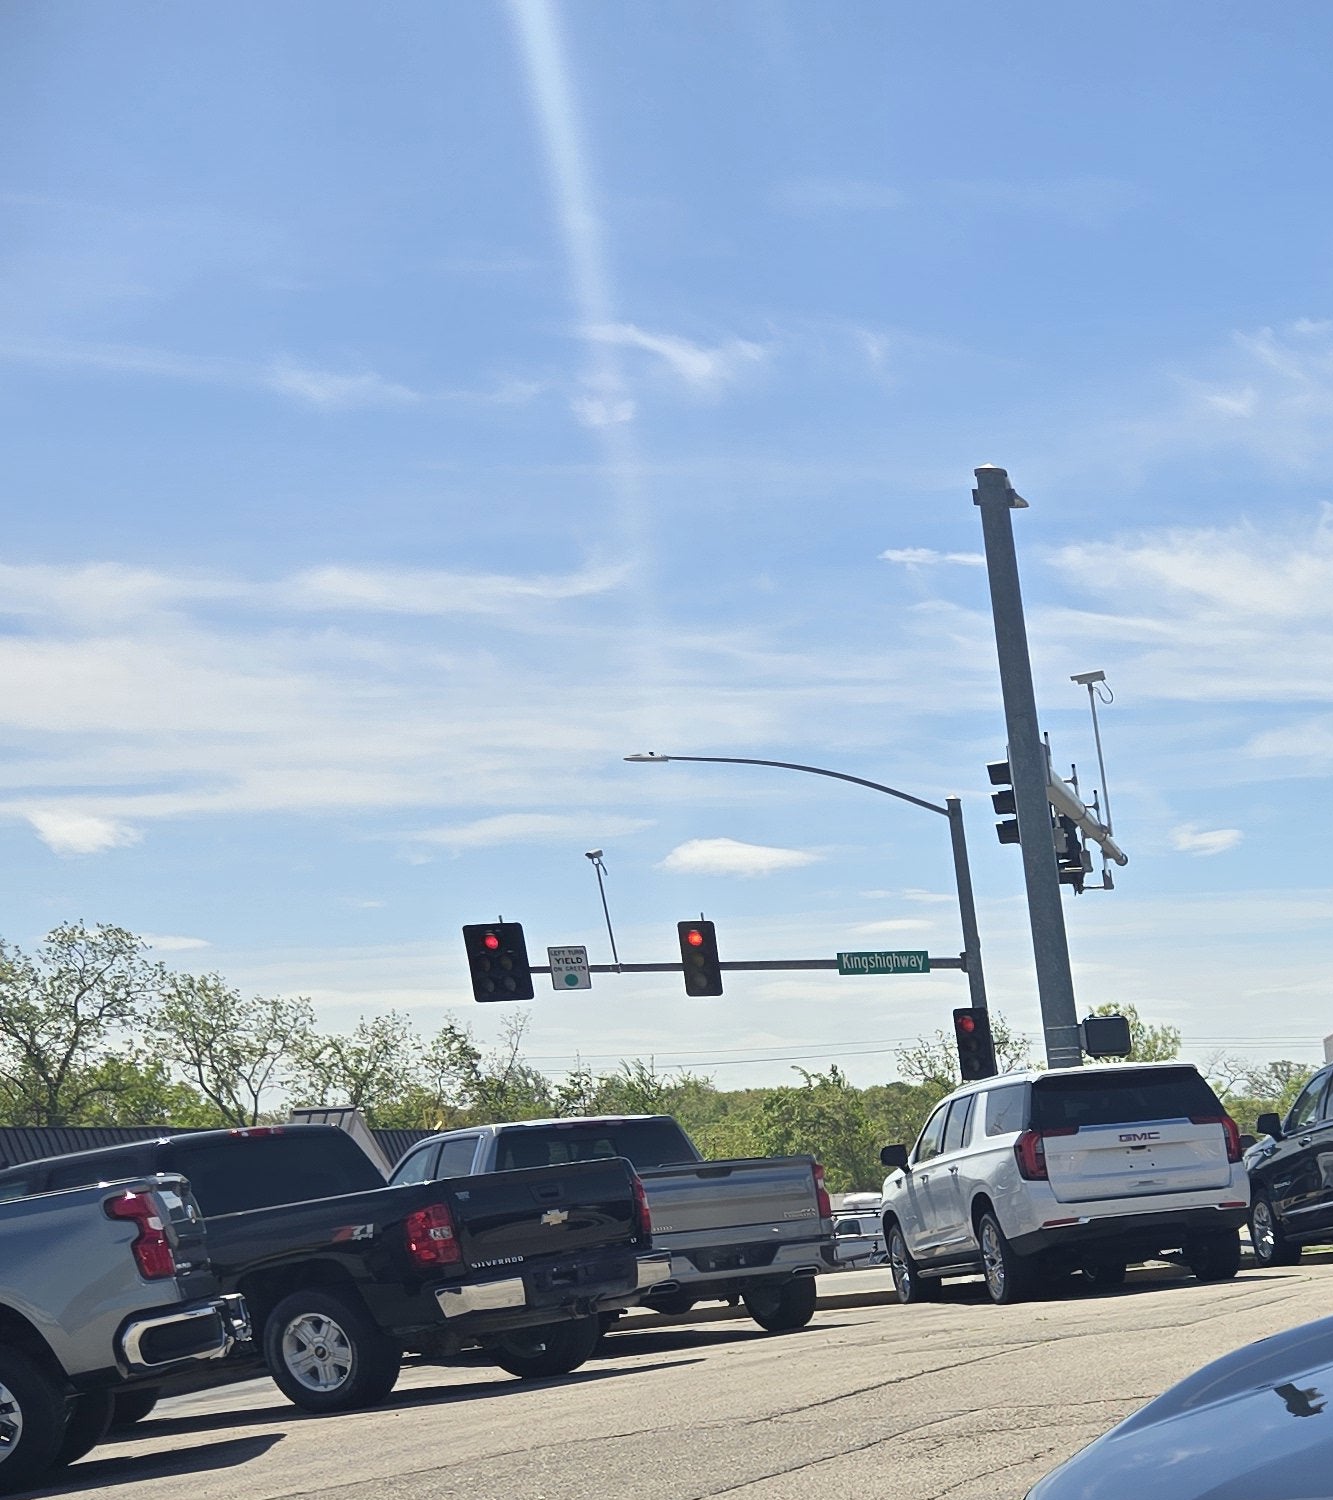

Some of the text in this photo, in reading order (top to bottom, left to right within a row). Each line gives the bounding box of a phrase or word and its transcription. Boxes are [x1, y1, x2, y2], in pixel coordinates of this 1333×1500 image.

[555, 957, 583, 965] YIELD
[842, 953, 924, 973] Kingshighway
[1118, 1132, 1161, 1143] GMC
[470, 1255, 524, 1269] SILVERADO
